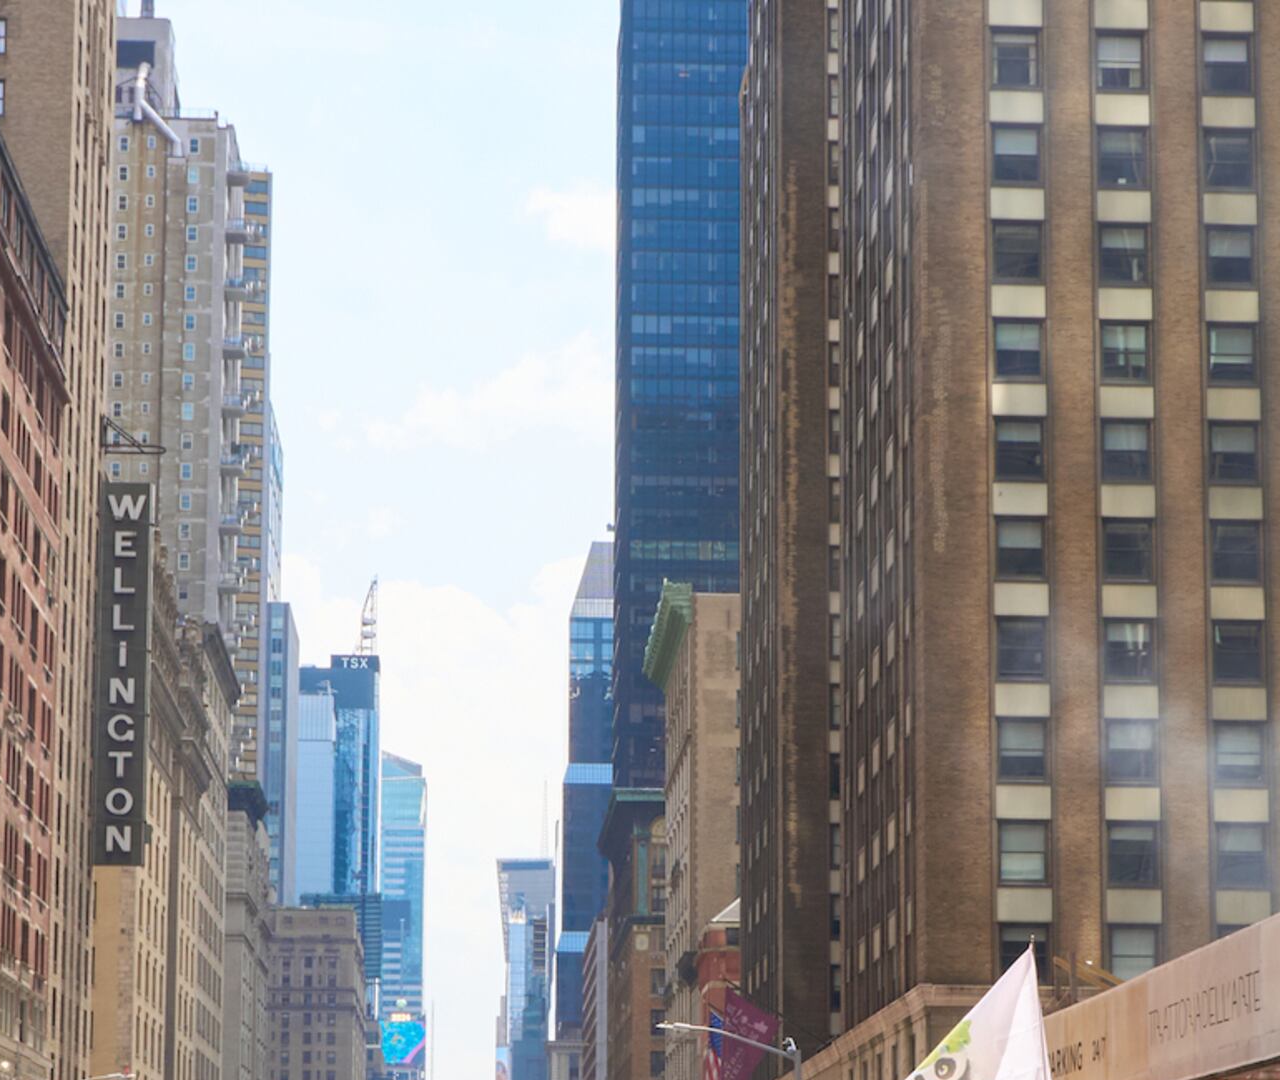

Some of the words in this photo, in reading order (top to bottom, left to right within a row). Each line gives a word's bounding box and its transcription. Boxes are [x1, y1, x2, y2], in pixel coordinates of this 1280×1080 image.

[104, 493, 146, 853] WELLINGTON
[341, 656, 368, 669] TSX
[1048, 1041, 1083, 1078] ARKING
